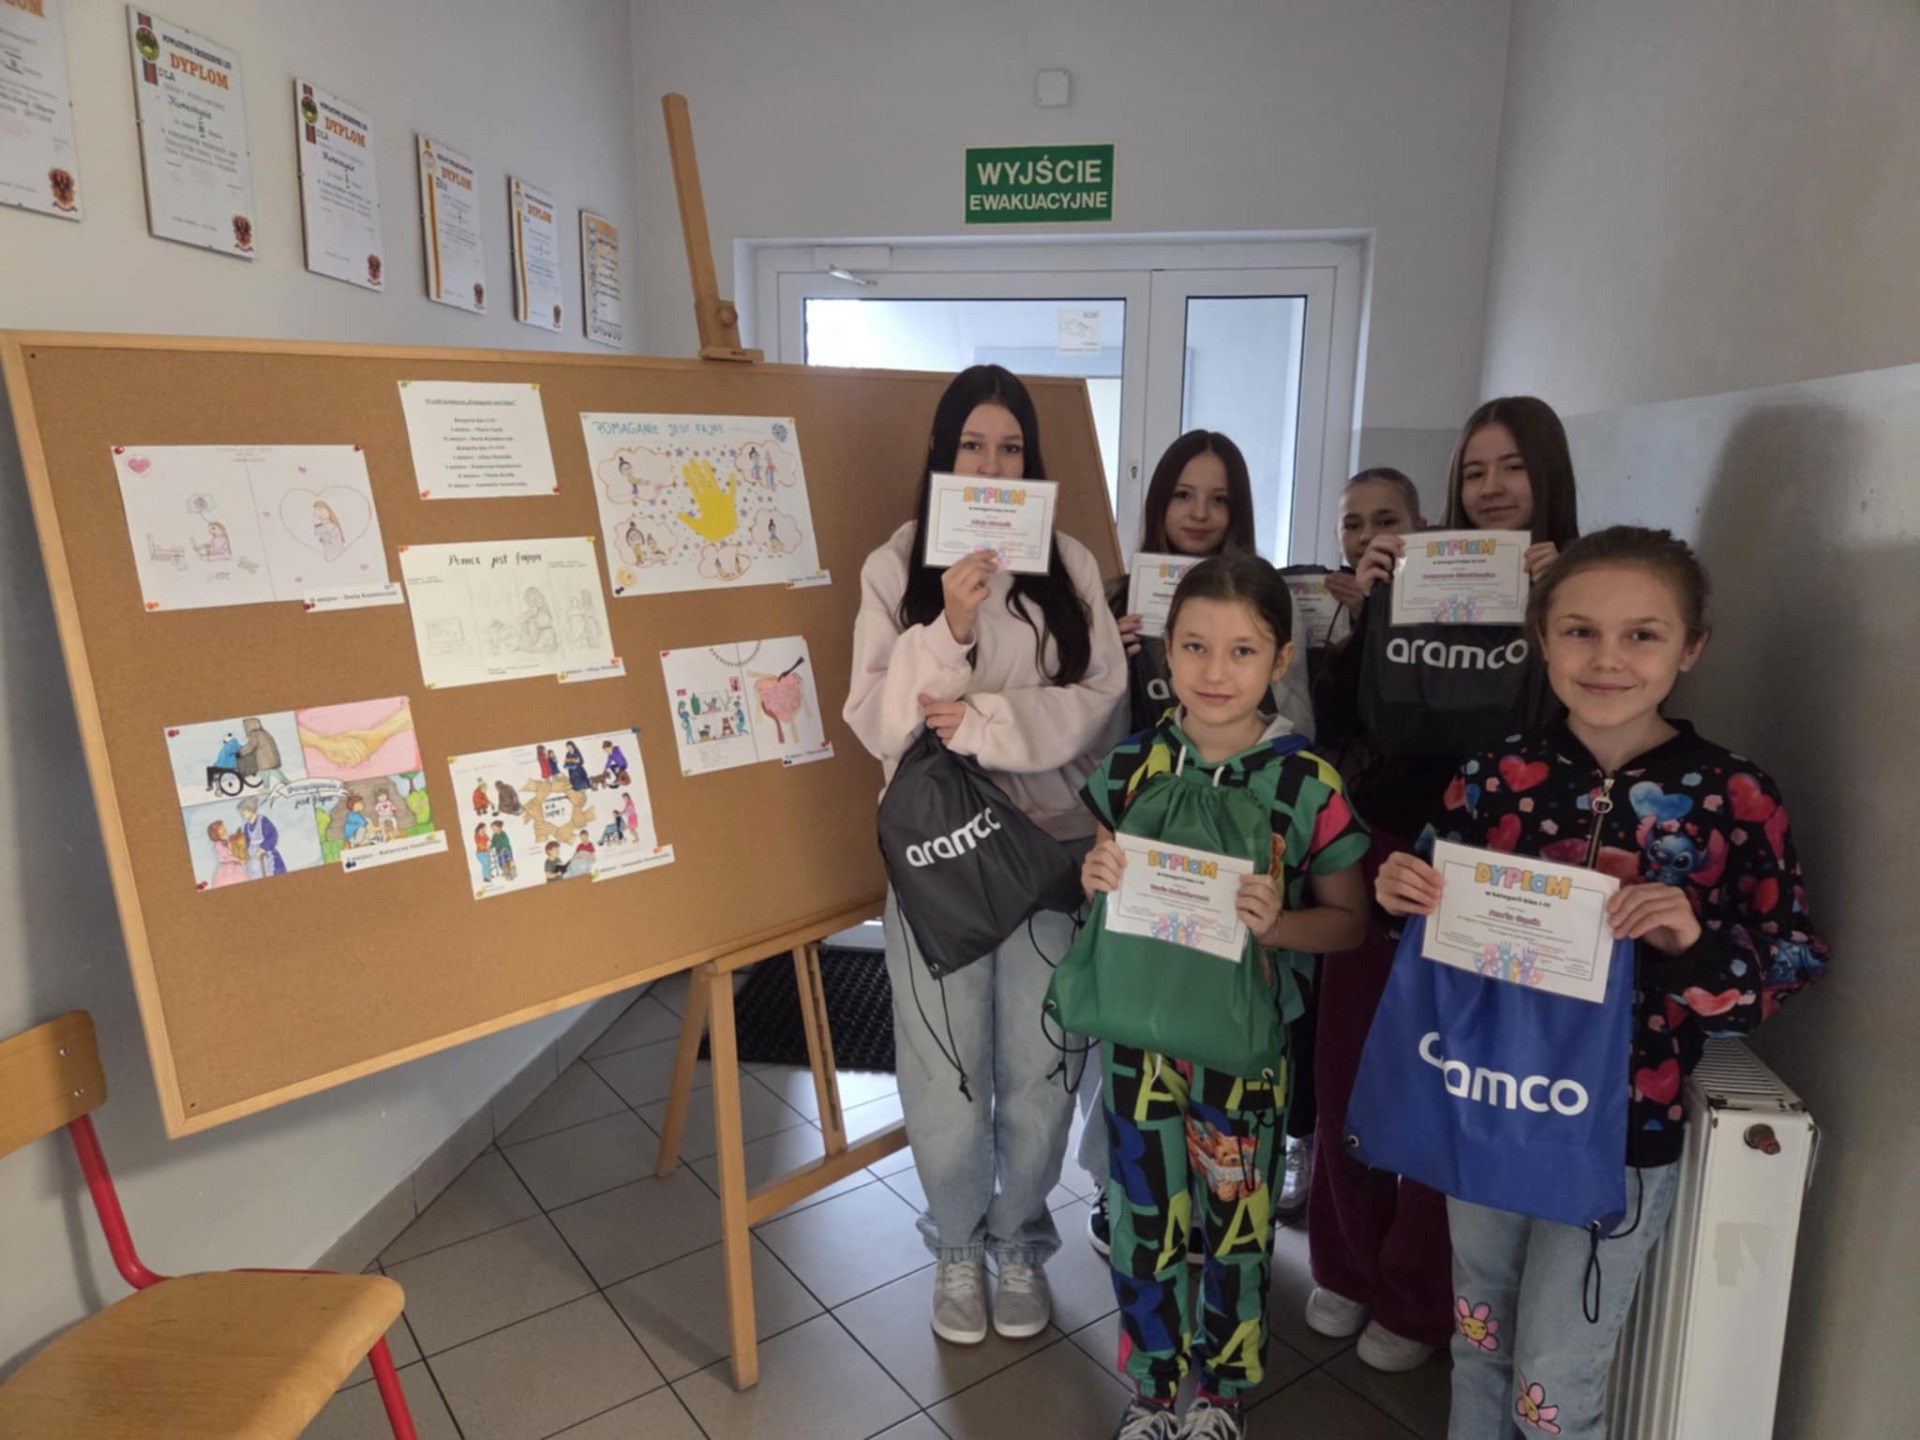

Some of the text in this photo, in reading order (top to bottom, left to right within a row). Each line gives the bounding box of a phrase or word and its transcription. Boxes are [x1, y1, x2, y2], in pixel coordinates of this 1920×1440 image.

[169, 51, 230, 90] DYPLOM
[324, 116, 366, 148] DYPLOM
[976, 154, 1102, 186] WYJŚCIE
[969, 191, 1108, 211] EWAKUACYJNE
[963, 486, 1026, 506] DYPLOM
[1426, 539, 1496, 557] DYPLOM
[1386, 637, 1529, 670] aramco
[1147, 849, 1218, 879] DYPLOM
[1474, 862, 1572, 900] DYPLOM
[1418, 1031, 1589, 1116] aamco
